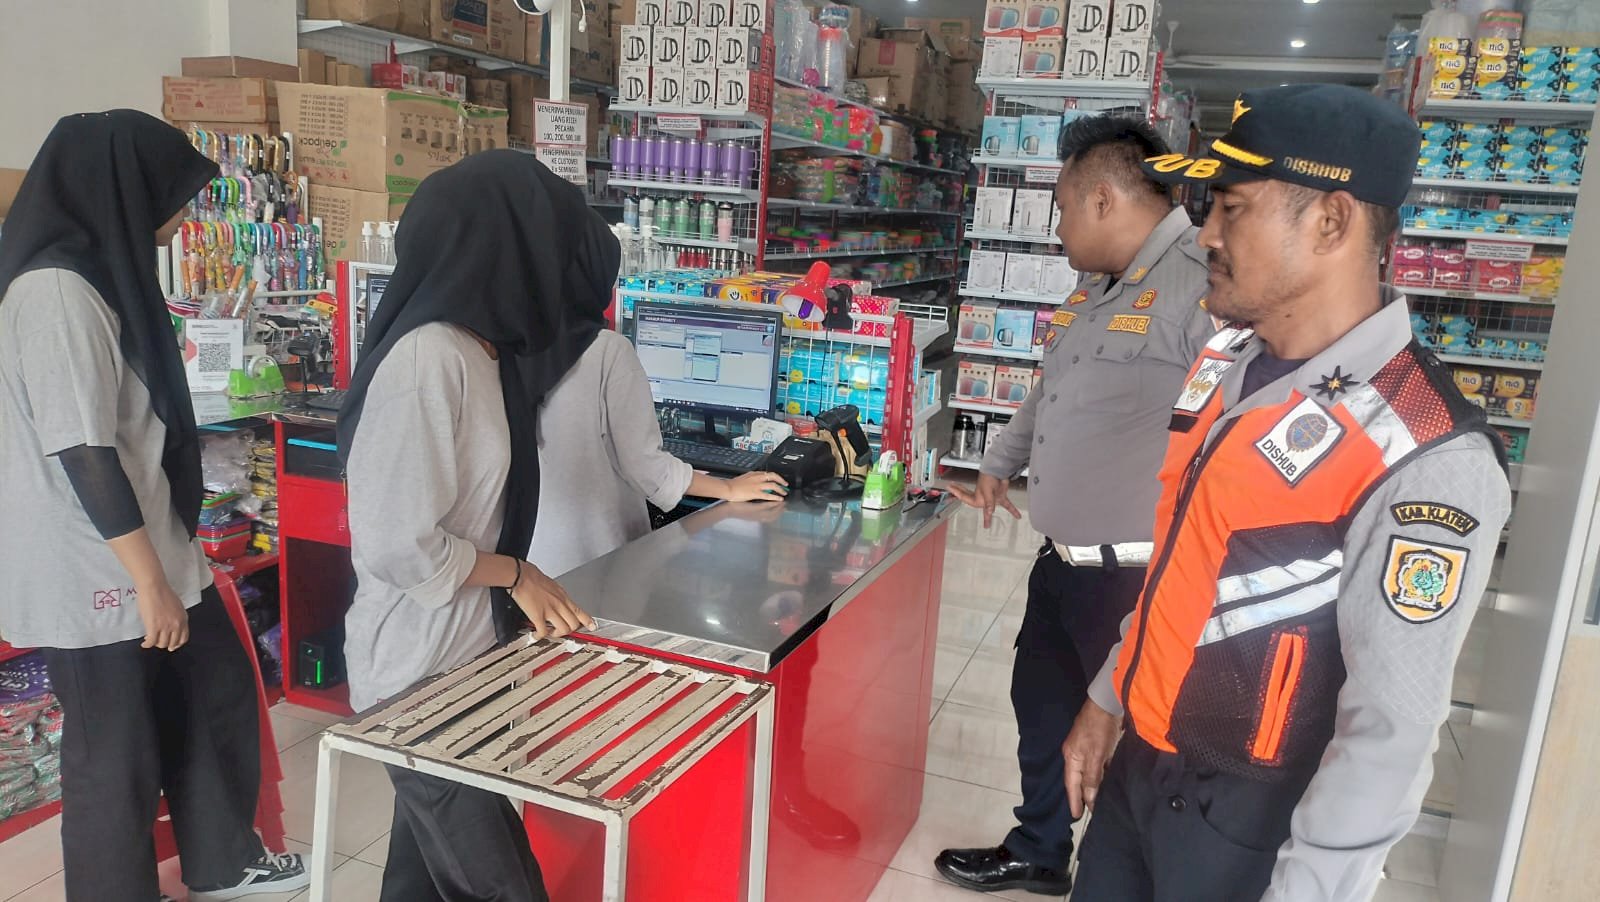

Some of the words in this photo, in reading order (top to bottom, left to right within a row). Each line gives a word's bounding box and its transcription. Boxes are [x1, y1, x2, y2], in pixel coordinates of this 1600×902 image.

[1110, 317, 1145, 331] DISHUB
[1262, 439, 1297, 477] DISHUB
[1427, 505, 1473, 532] KLATEN
